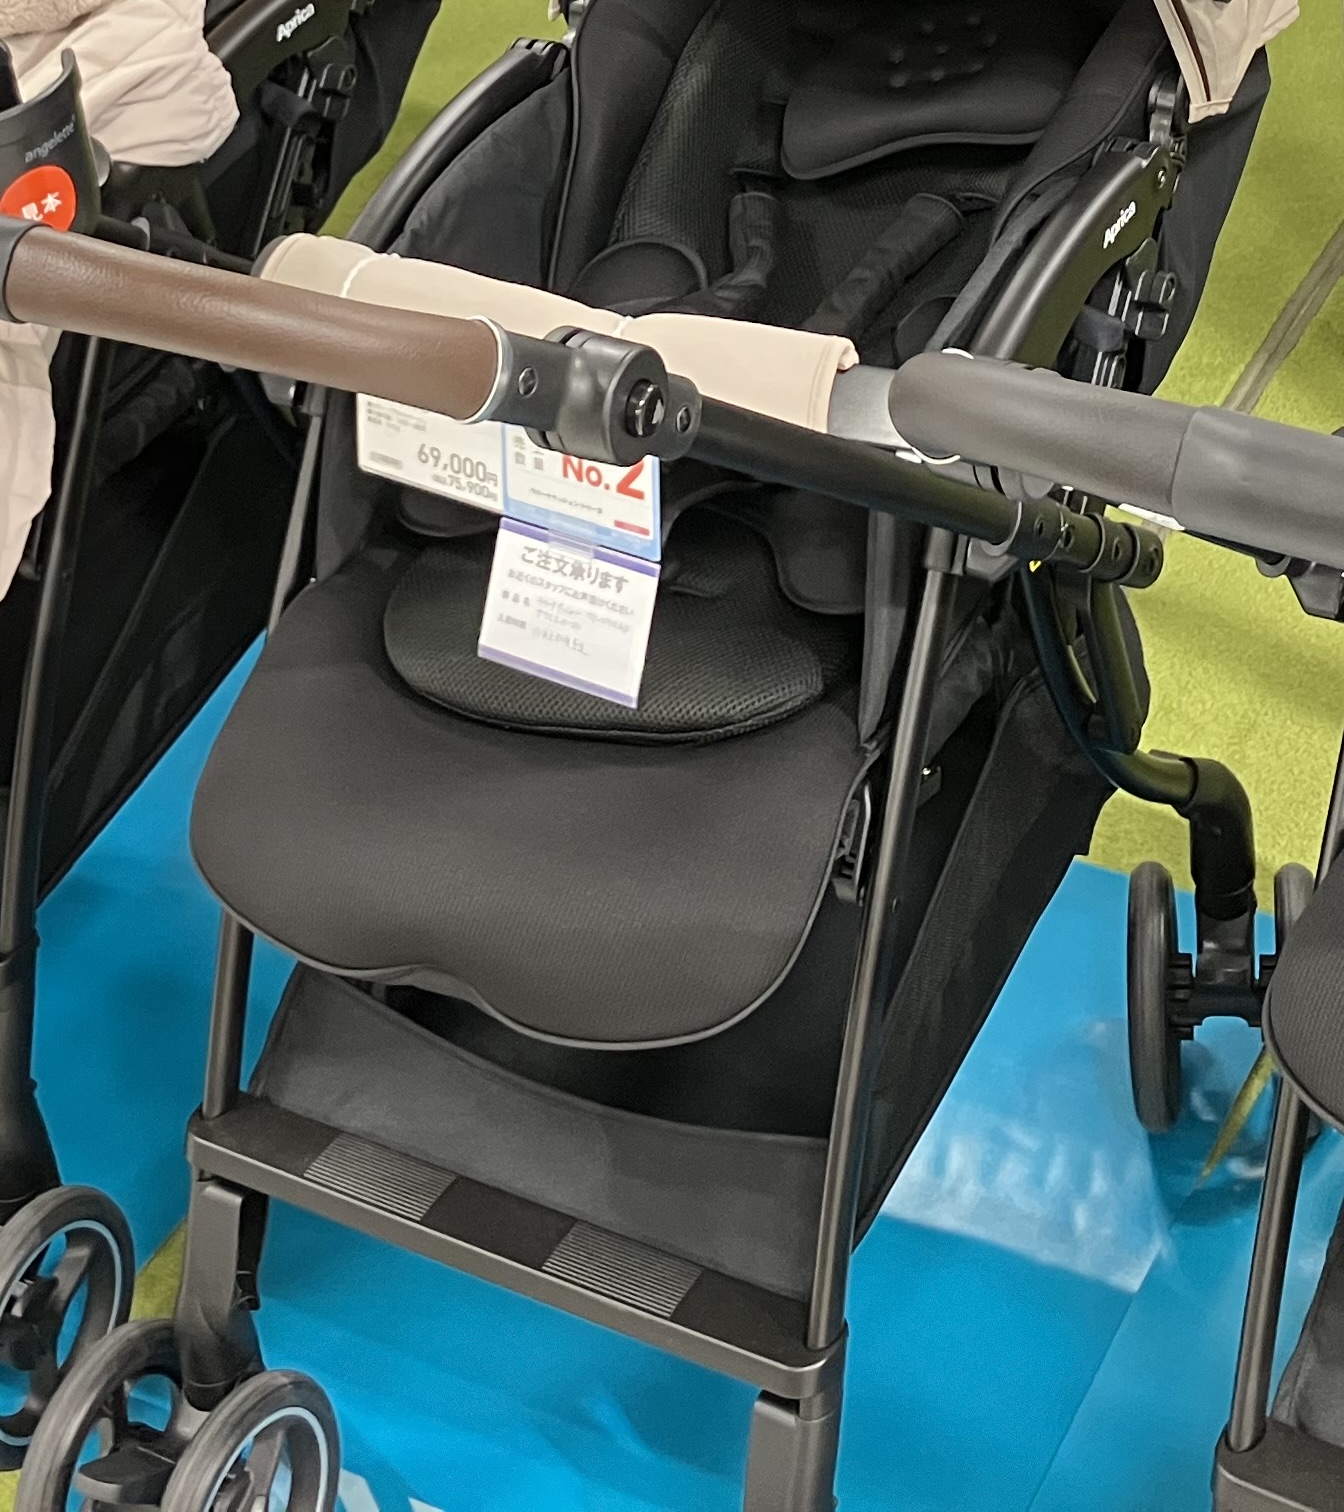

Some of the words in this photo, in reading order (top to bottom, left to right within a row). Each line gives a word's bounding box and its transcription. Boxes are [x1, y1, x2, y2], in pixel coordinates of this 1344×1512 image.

[417, 443, 498, 487] 69,000円
[520, 545, 630, 593] ご注文承ります
